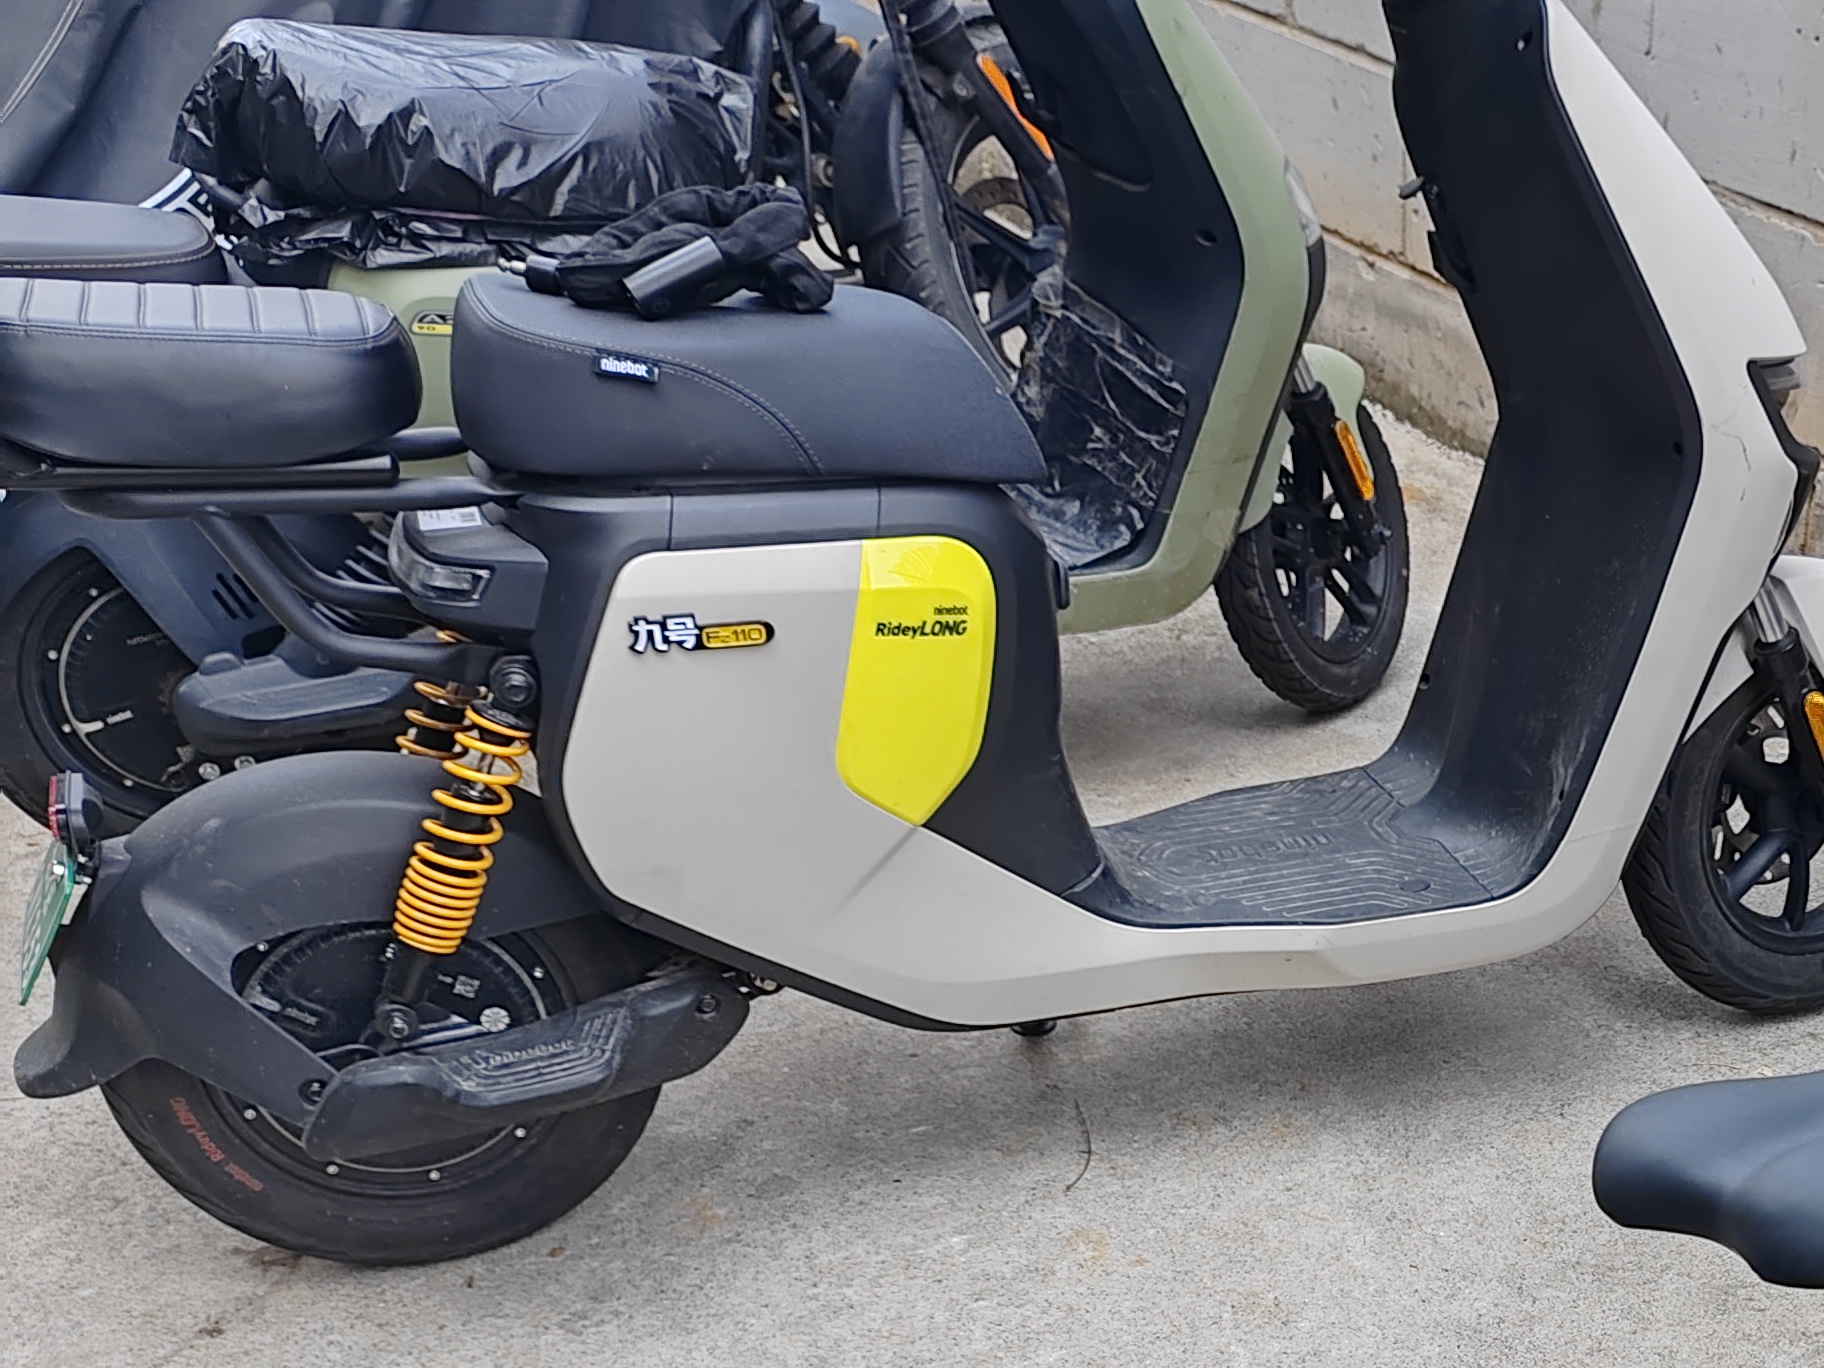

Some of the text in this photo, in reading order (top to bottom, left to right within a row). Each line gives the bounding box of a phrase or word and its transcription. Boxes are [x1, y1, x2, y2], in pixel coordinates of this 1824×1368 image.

[600, 357, 649, 378] ninebot
[933, 604, 968, 616] ninebot
[631, 616, 700, 652] 九号
[875, 619, 968, 639] RideyLONG
